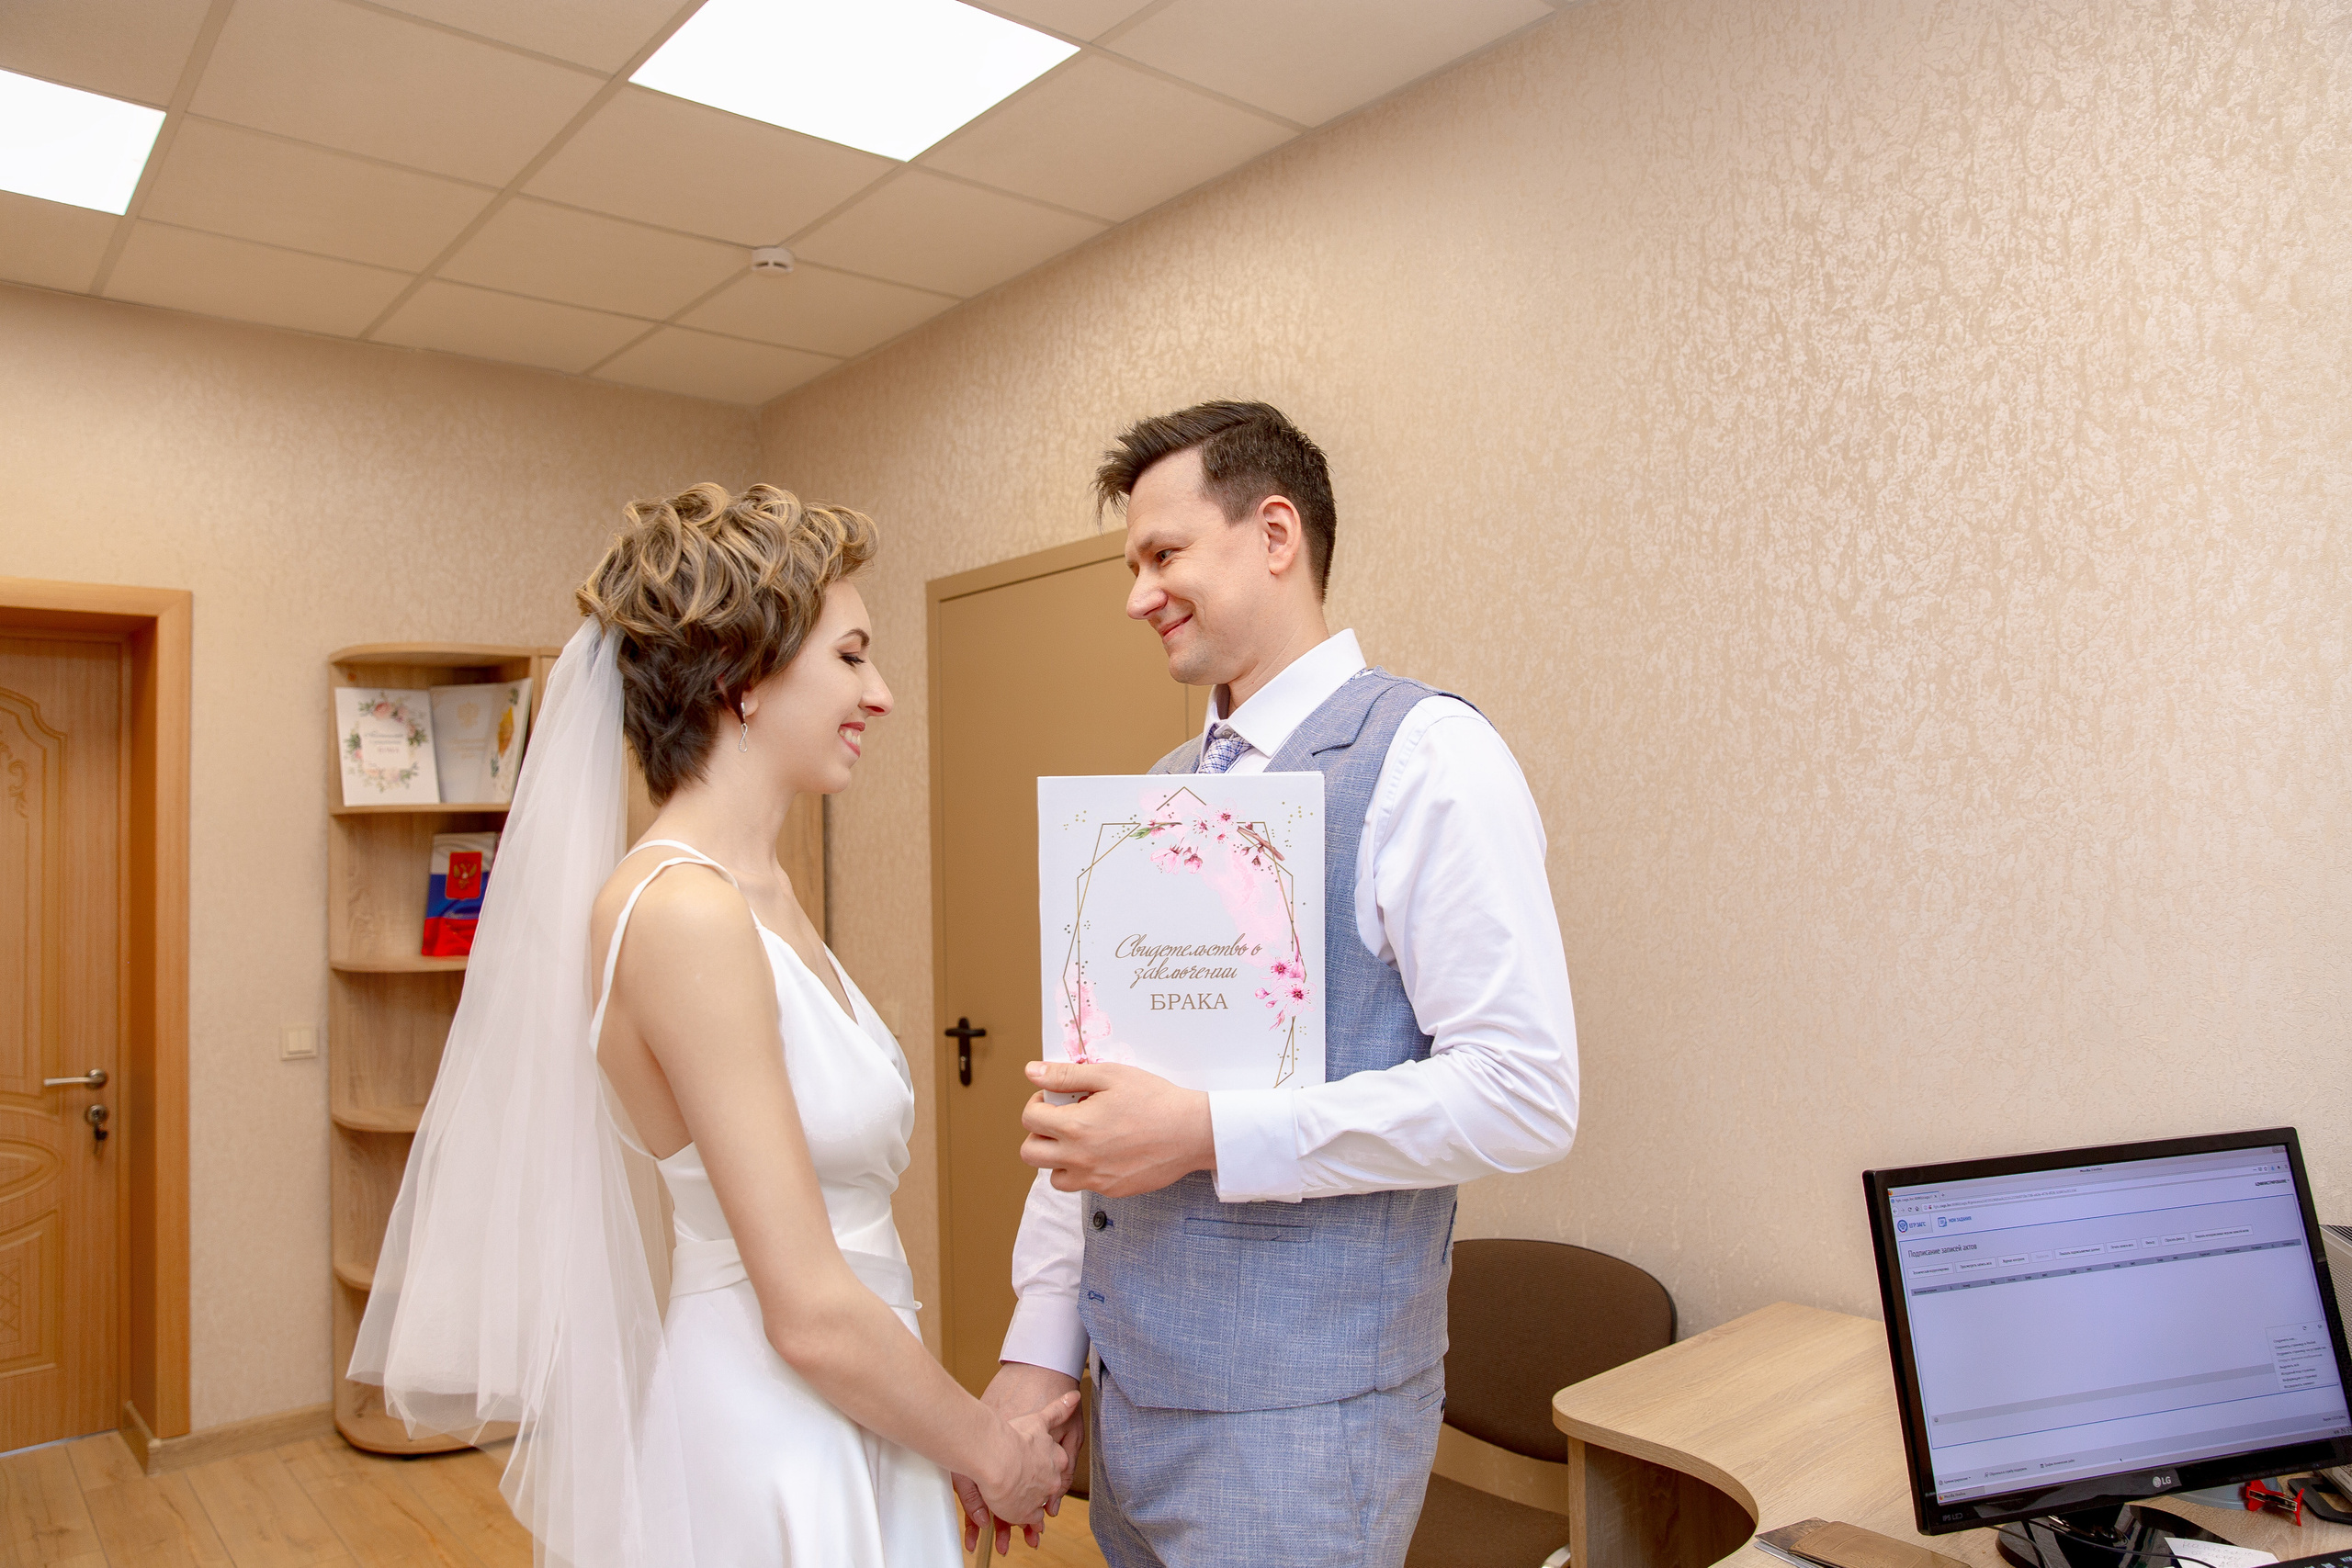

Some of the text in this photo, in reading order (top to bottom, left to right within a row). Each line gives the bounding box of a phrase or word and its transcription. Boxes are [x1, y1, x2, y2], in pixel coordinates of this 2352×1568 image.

[1114, 932, 1263, 966] Свидетельство о
[1130, 957, 1238, 989] заключении
[1150, 993, 1229, 1010] БРАКА
[1908, 1249, 1940, 1258] Подписание
[1941, 1244, 1962, 1254] записей
[2161, 1476, 2172, 1485] LG
